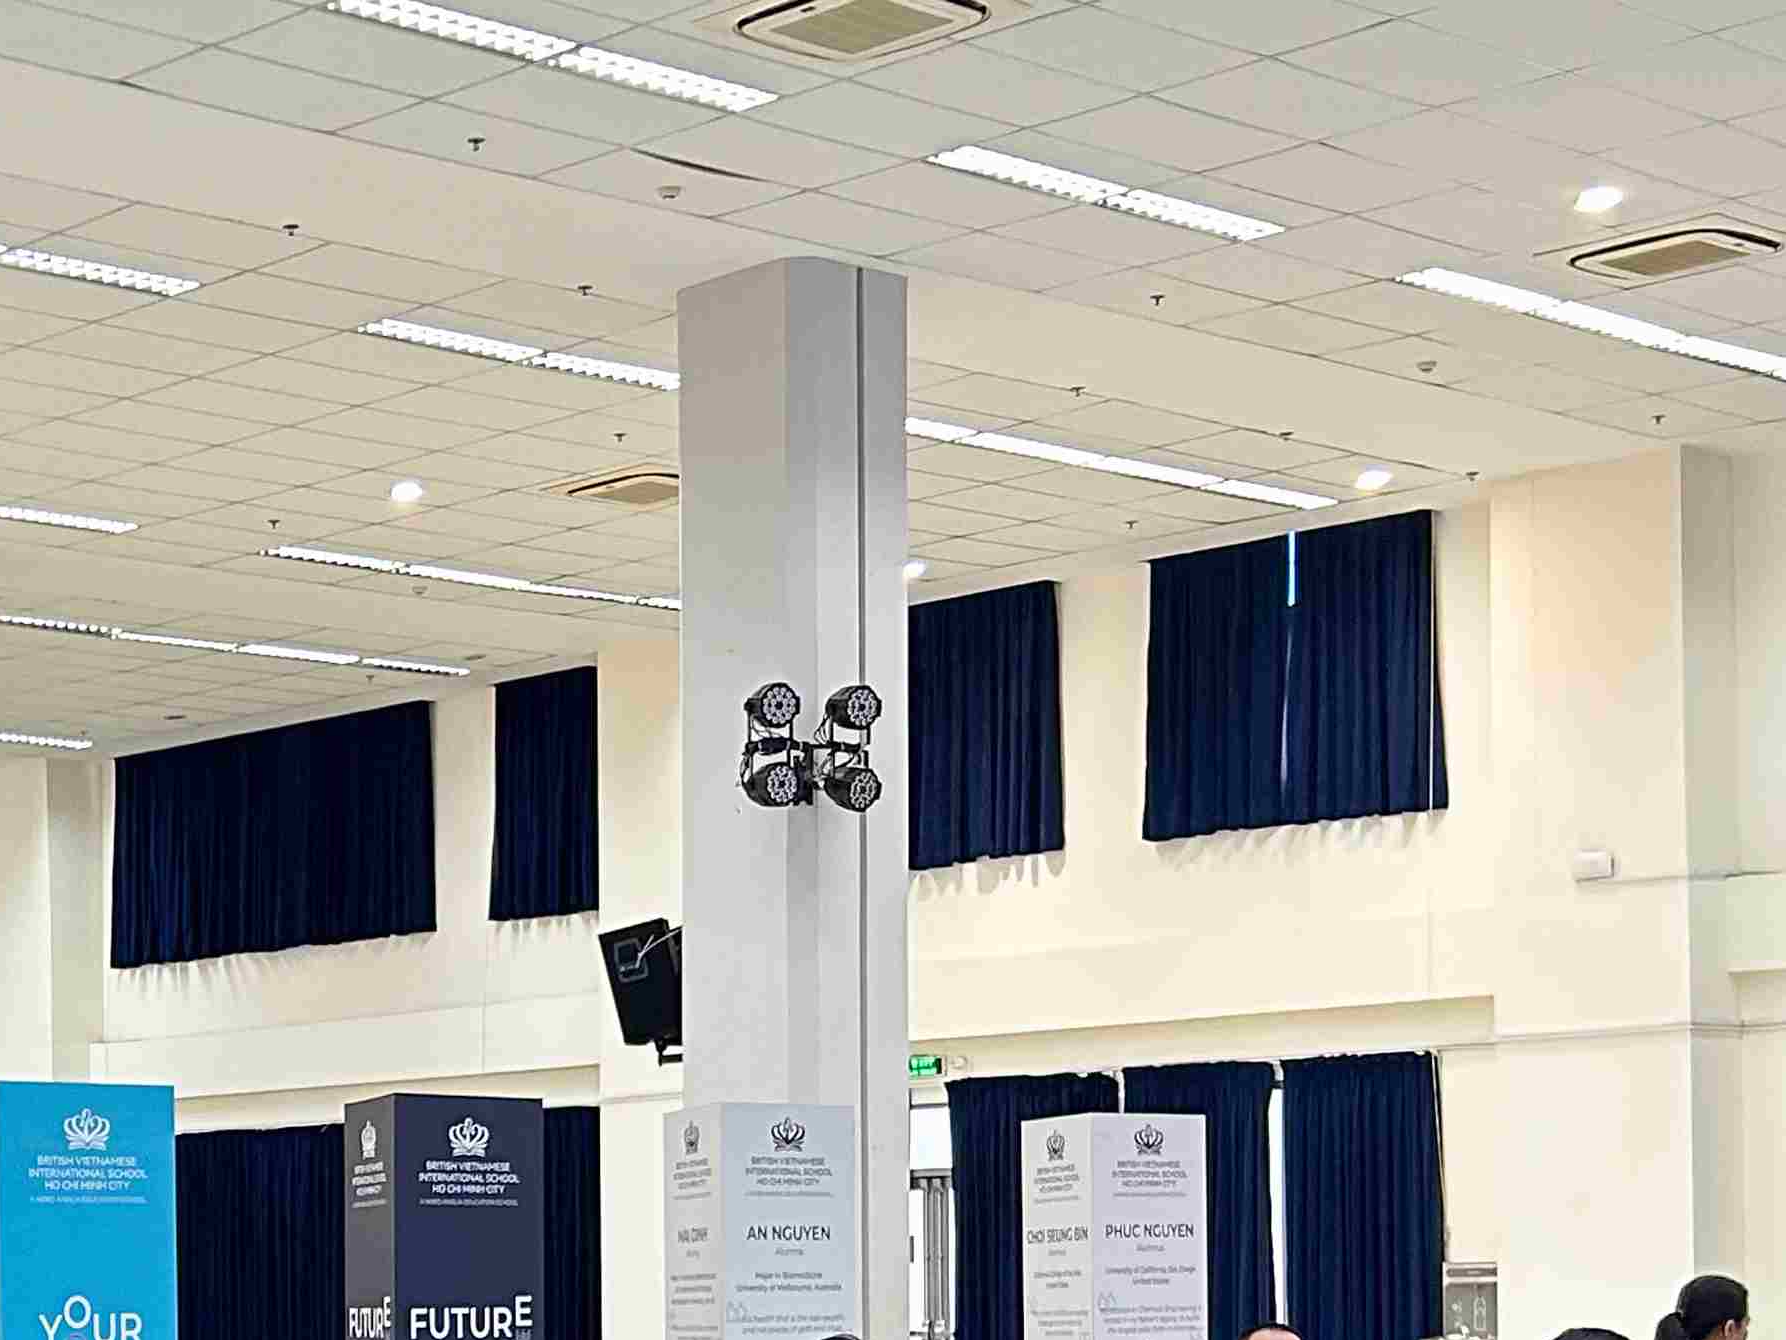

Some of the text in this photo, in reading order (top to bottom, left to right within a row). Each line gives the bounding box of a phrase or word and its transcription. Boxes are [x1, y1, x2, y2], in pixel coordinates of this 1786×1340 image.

[746, 1225, 831, 1241] AN NGUYEN
[1105, 1223, 1194, 1239] PHUC NGUYEN
[348, 1296, 392, 1340] FUTURE
[409, 1295, 533, 1340] FUTURE
